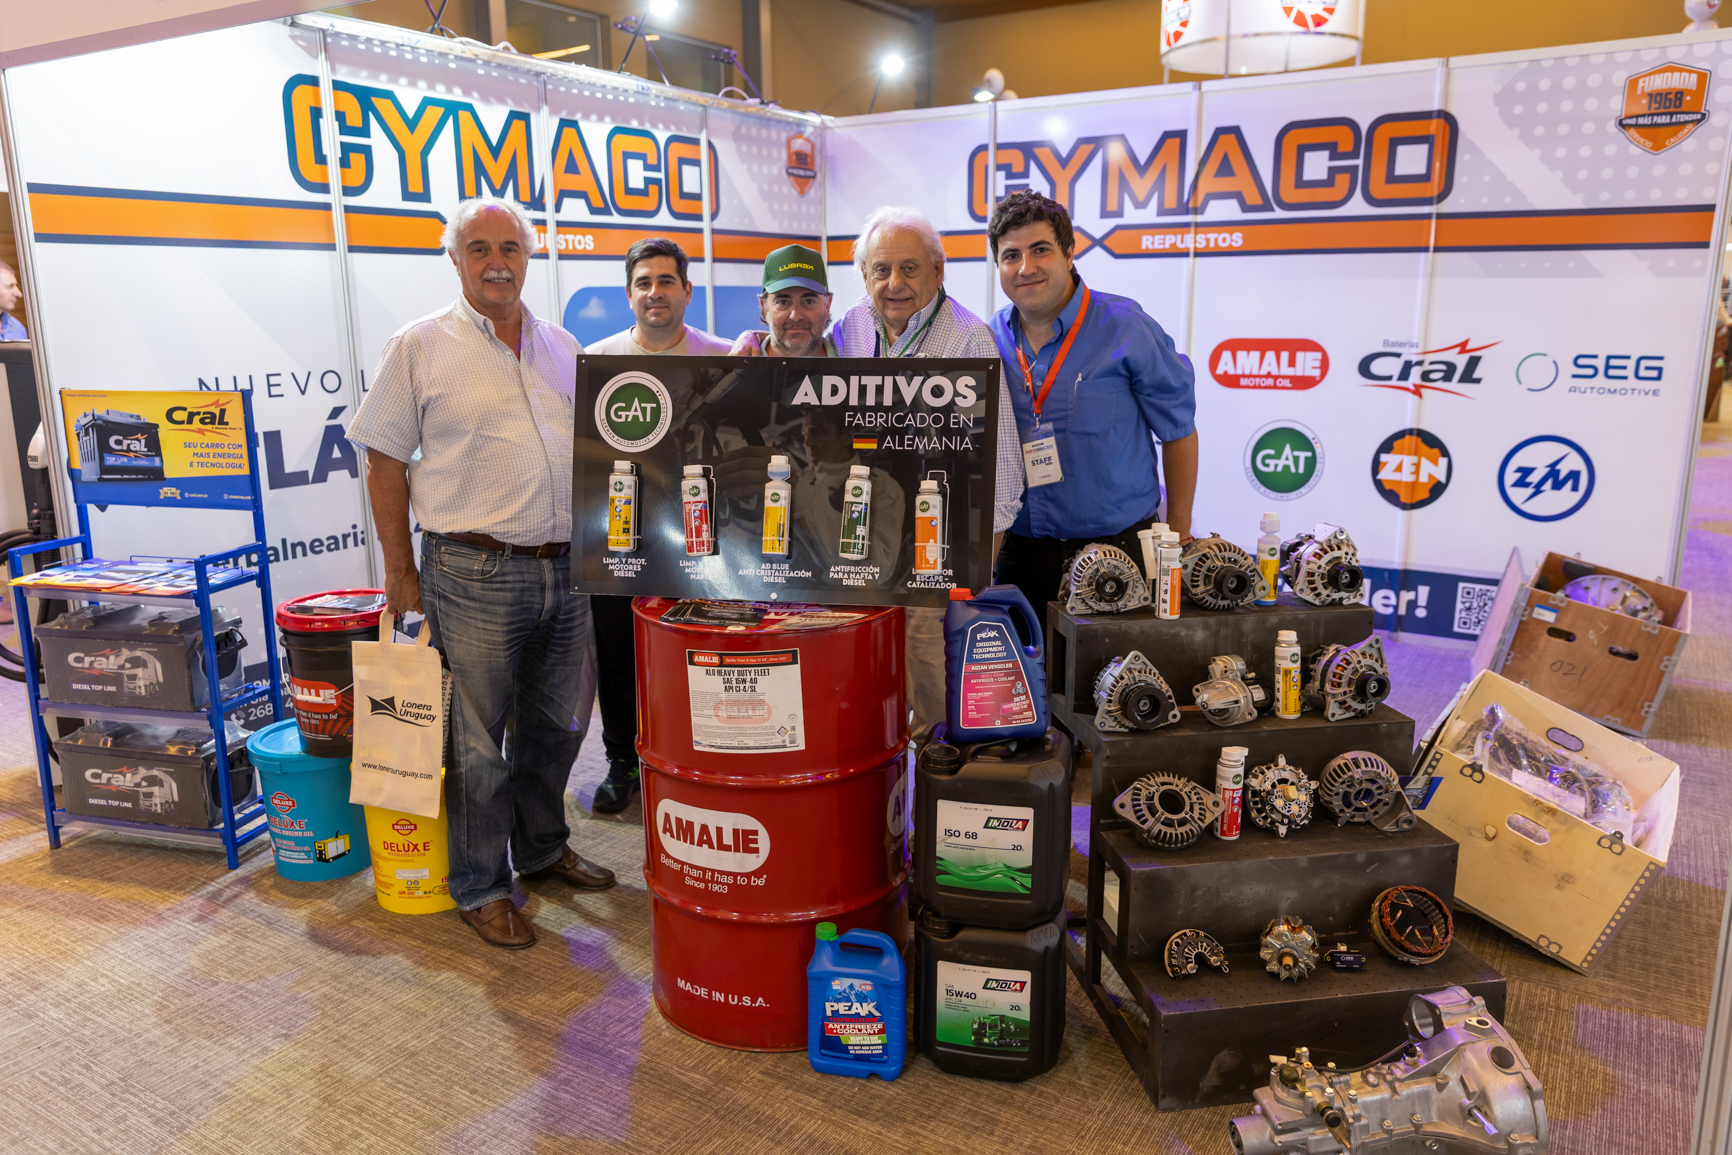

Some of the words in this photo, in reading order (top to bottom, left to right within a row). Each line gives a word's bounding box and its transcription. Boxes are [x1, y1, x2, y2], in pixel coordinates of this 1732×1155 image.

[1636, 72, 1698, 95] FUNDADA
[1647, 90, 1685, 111] 1968
[1637, 113, 1652, 125] MÁS
[1652, 114, 1671, 124] PARA
[1671, 113, 1702, 122] ATENDER
[1664, 122, 1694, 146] CALIDAD
[283, 73, 720, 222] CYMACO
[968, 109, 1459, 223] CYMACO
[1141, 232, 1244, 250] REPUESTOS
[1382, 338, 1420, 349] Baterías
[1215, 350, 1322, 377] AMALIE
[1570, 354, 1665, 382] SEG
[1240, 377, 1274, 387] MOTOR
[1276, 378, 1293, 388] OIL
[790, 374, 978, 408] ADITIVOS
[1568, 386, 1661, 398] AUTOMOTIVE
[165, 406, 230, 426] CraL
[610, 396, 657, 423] GAT
[602, 418, 616, 439] GERMAN
[616, 438, 650, 446] AUTOMOTIVE
[651, 402, 666, 438] TECHNOLOGY
[844, 412, 945, 428] FABRICADO
[950, 414, 974, 428] EN
[108, 435, 148, 452] CraL
[882, 435, 974, 451] ALEMANIA
[212, 452, 244, 460] ENERGIA
[1031, 456, 1052, 466] STAFF
[1256, 442, 1313, 474] GAT
[196, 461, 246, 470] TECNOLOGIA!
[1376, 452, 1448, 485] ZEN
[1509, 458, 1582, 497] ZM
[756, 570, 812, 578] CRISTALIZACIÓN
[830, 564, 880, 573] ANTIFRICCIÓN
[906, 581, 957, 590] CATALIZADOR
[976, 630, 1000, 640] PEAK
[67, 652, 118, 670] CraL
[705, 668, 716, 676] XLO
[754, 668, 770, 676] FLEET
[1549, 660, 1588, 686] 021
[401, 700, 432, 712] Lonera
[400, 708, 437, 723] Uruguay
[84, 768, 135, 787] CraL
[269, 814, 306, 830] DELUXE
[985, 818, 1026, 829] IMOLA
[662, 812, 760, 854] AMALIE
[944, 828, 961, 838] ISO
[964, 831, 978, 840] 68
[383, 838, 431, 853] DELUXE
[660, 853, 682, 872] Better
[683, 865, 703, 879] than
[706, 870, 712, 880] it
[714, 872, 734, 884] has
[737, 875, 748, 885] to
[751, 876, 766, 886] be
[684, 876, 706, 889] Since
[708, 883, 728, 894] 1903
[677, 977, 709, 999] MADE
[712, 990, 724, 1003] IN
[728, 994, 770, 1007] U.S.A.
[984, 979, 1024, 991] IMOLA
[945, 988, 977, 1000] 15W40
[824, 1002, 882, 1017] PEAK
